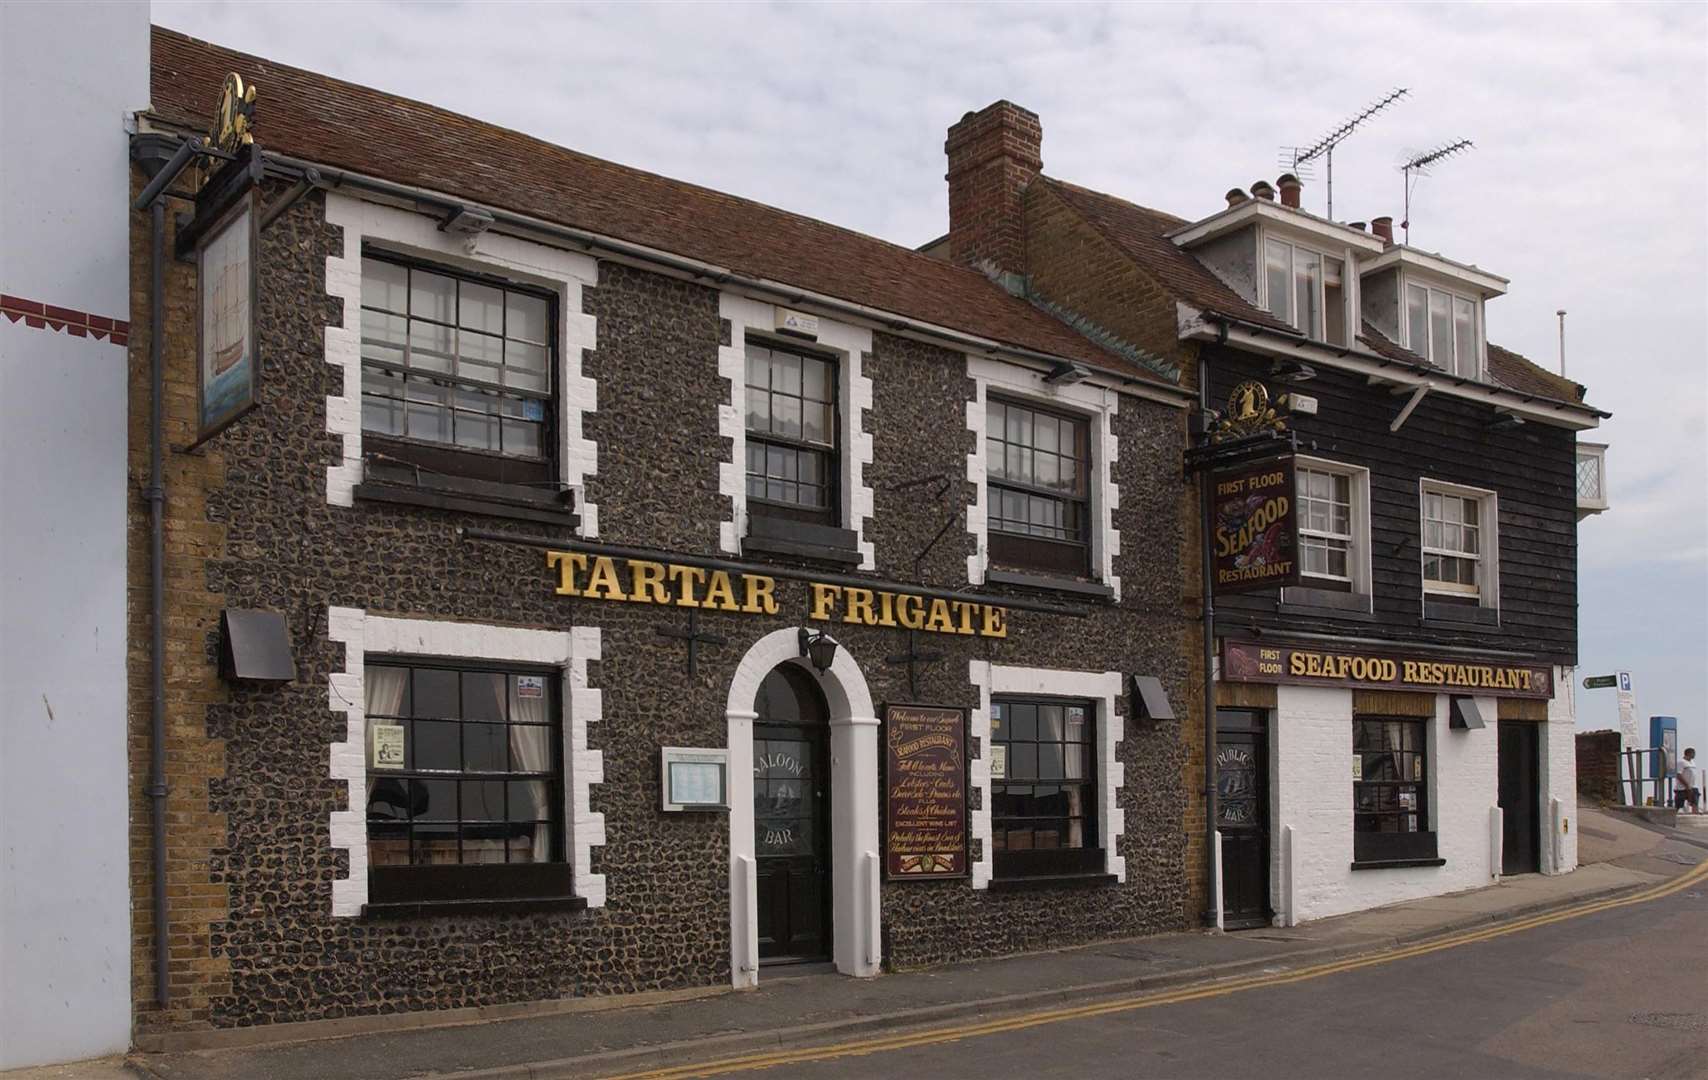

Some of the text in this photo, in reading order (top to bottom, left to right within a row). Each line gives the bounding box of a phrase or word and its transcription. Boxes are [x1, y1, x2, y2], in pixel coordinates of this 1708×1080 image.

[1217, 472, 1284, 495] FIRST FLOOR
[1216, 496, 1289, 557] SEAFOOD
[1219, 561, 1292, 583] RESTAURANT
[546, 551, 1008, 638] TARTAR FRIGATE
[1260, 649, 1281, 660] FIRST
[1260, 663, 1283, 673] FLOOR
[1290, 651, 1532, 689] SEAFOOD RESTAURANT
[1622, 674, 1629, 689] P
[765, 829, 793, 845] BAR
